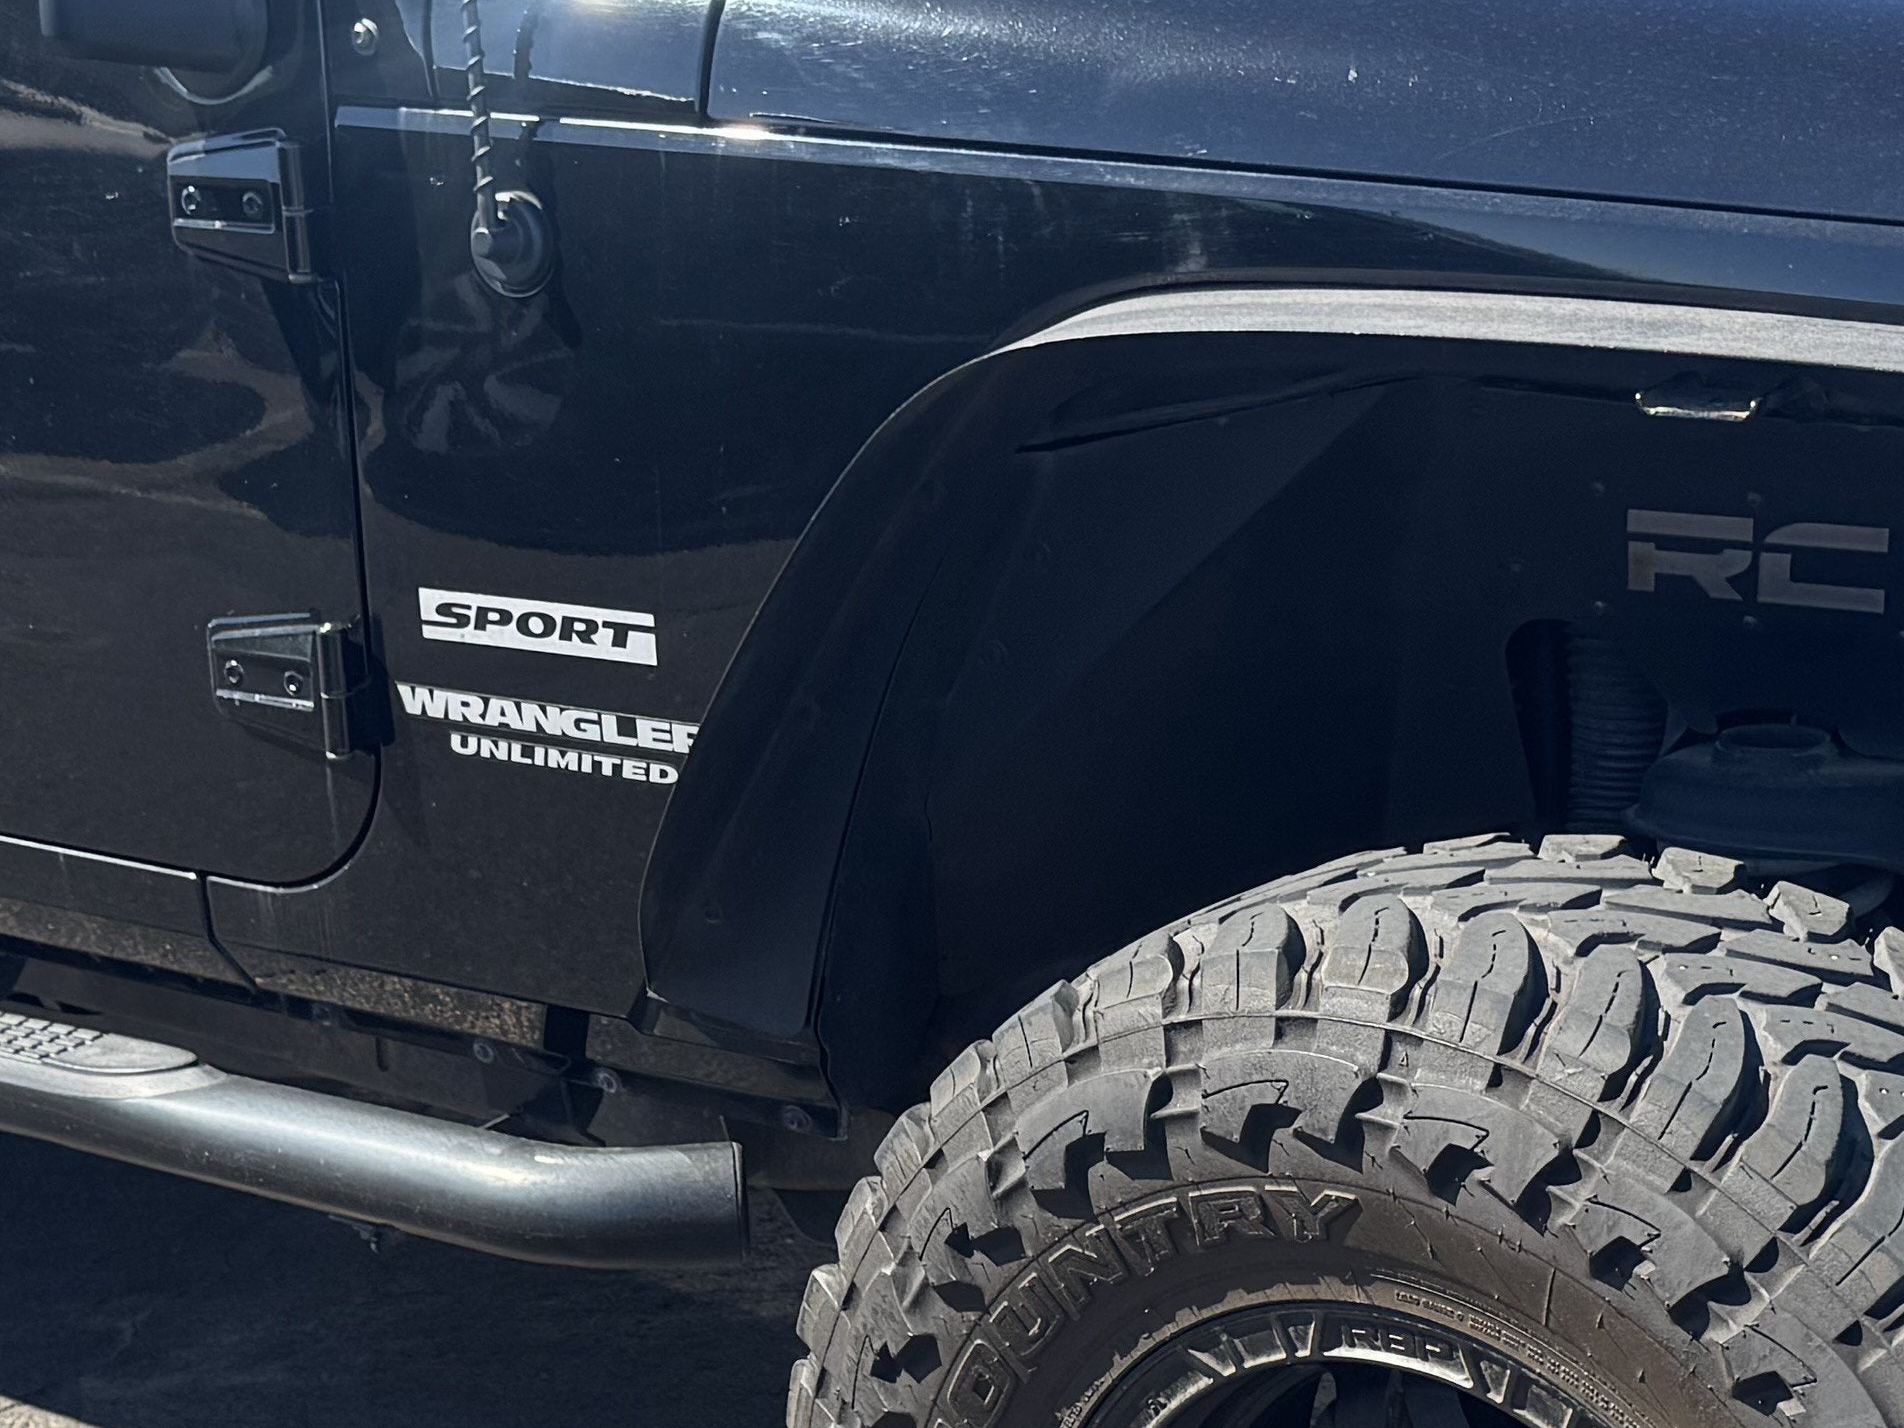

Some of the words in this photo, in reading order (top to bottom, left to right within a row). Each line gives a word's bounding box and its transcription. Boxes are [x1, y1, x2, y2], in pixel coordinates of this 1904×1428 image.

[1626, 508, 1890, 615] RC
[423, 598, 656, 650] SPORT
[450, 732, 680, 786] UNLIMITED
[1343, 1324, 1456, 1363] RBP
